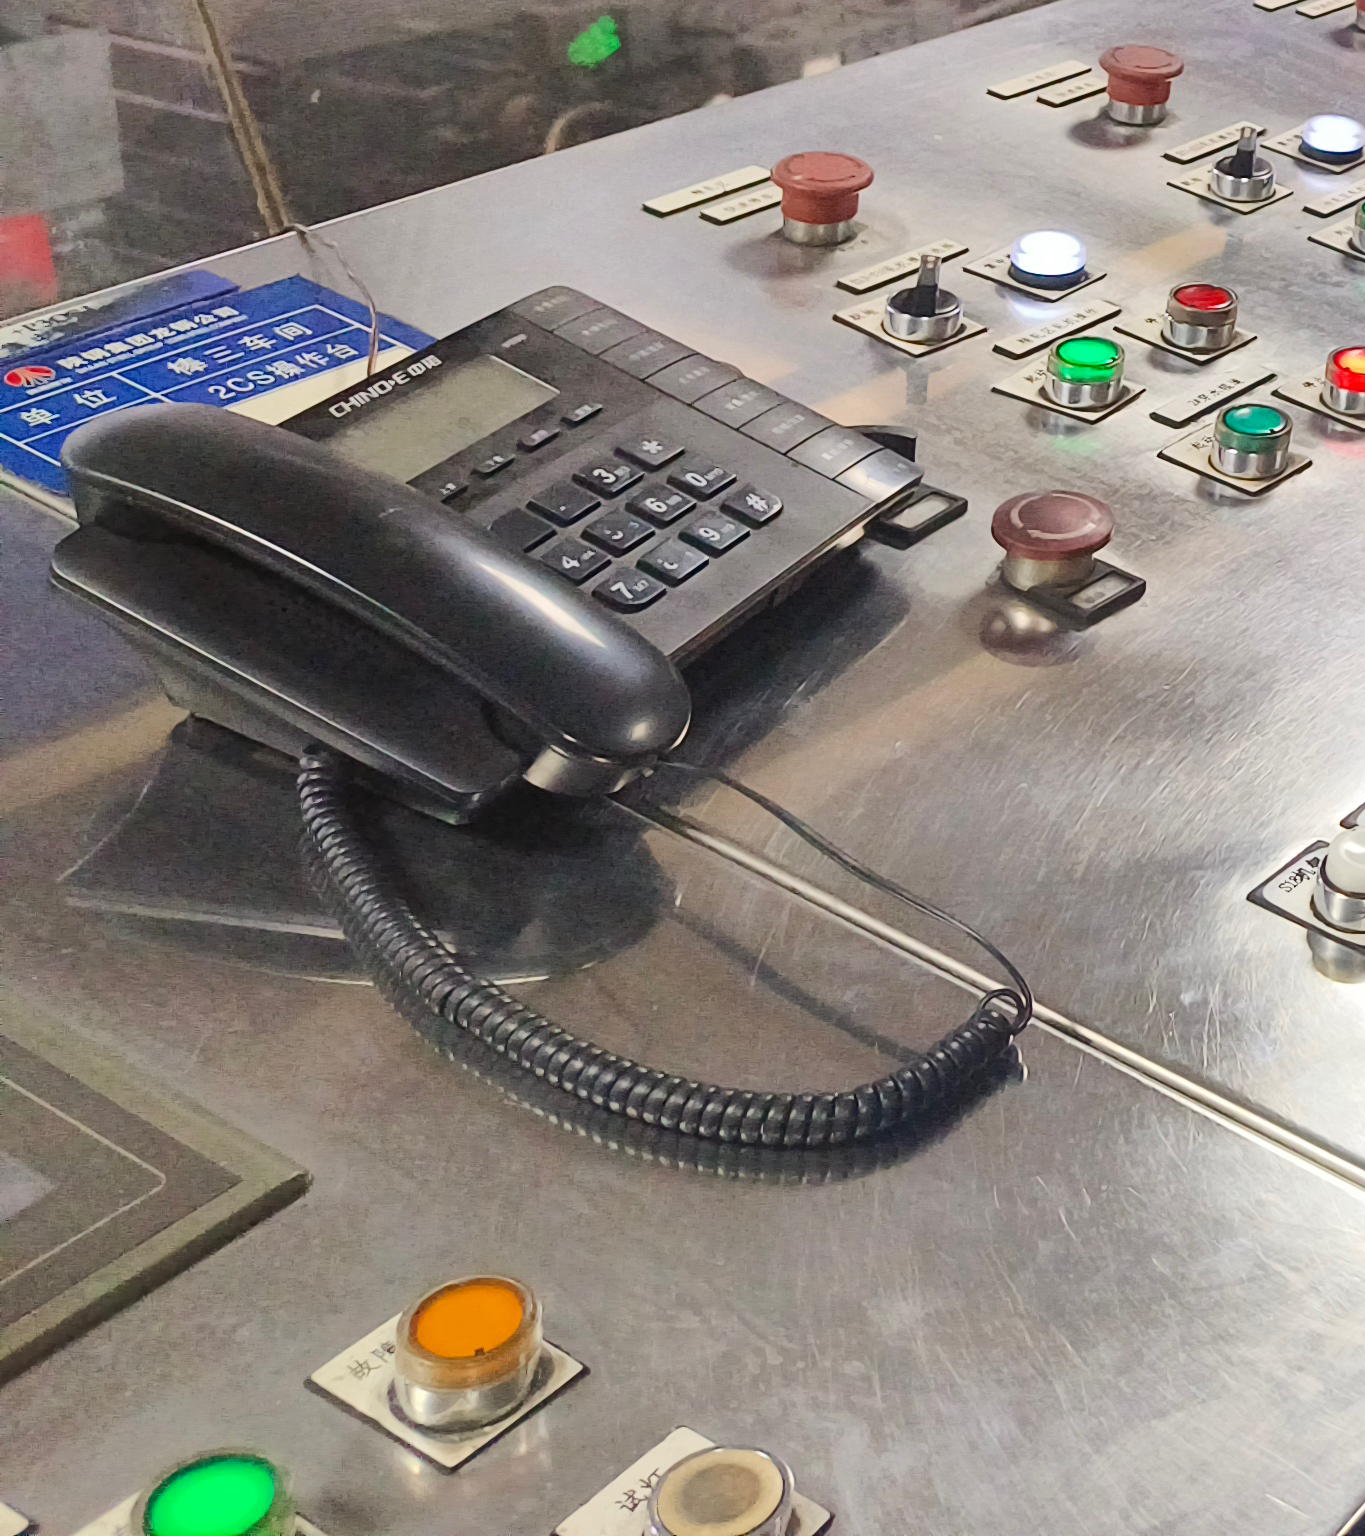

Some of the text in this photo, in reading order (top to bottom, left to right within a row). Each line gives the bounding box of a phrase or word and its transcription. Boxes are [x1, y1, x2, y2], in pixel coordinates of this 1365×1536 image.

[592, 467, 617, 484] 3
[684, 472, 708, 488] 0
[642, 496, 668, 514] 6
[698, 525, 722, 542] 9
[561, 554, 581, 570] 4
[609, 580, 634, 601] 7
